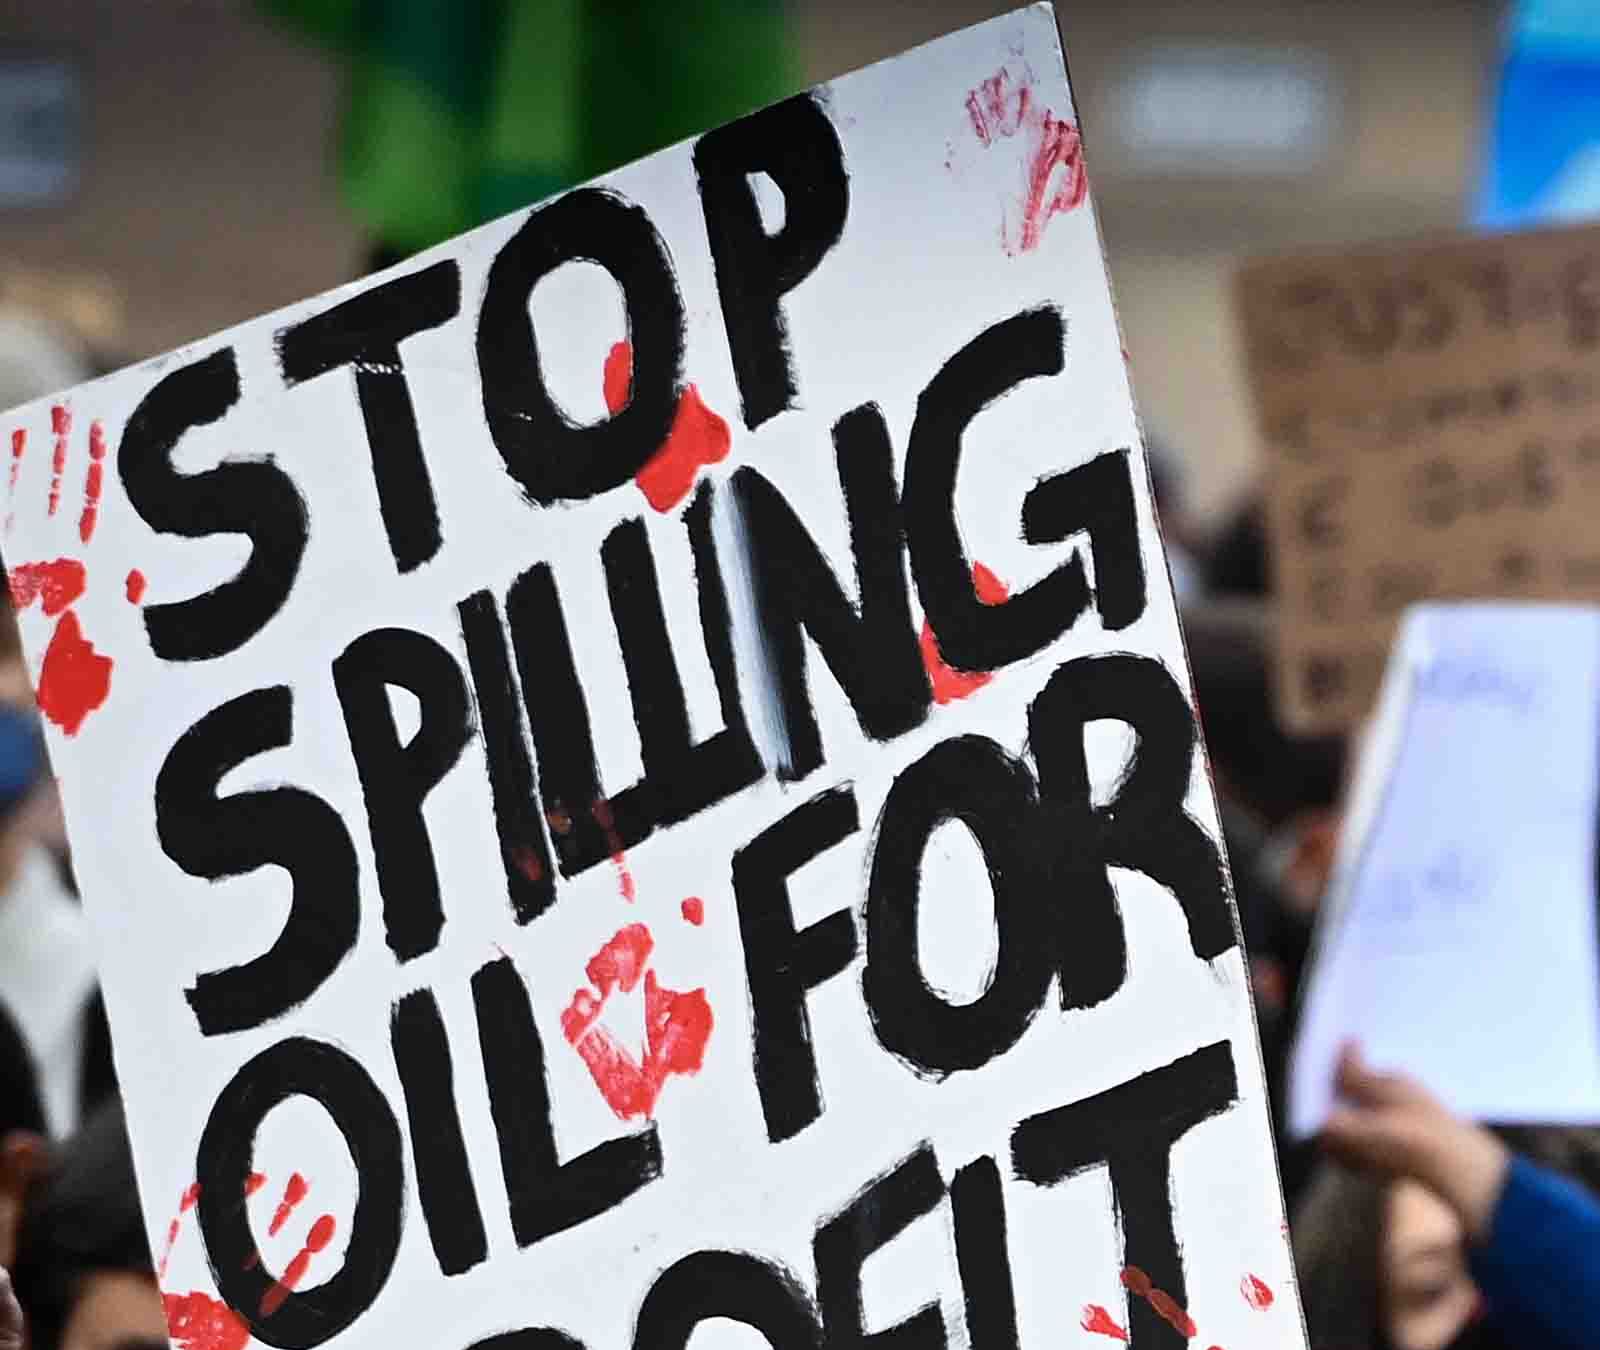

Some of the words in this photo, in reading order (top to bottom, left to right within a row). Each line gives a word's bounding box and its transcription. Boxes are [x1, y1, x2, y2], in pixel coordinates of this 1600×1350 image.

[117, 90, 850, 662] STOP
[155, 303, 1146, 1036] SPILLING
[732, 653, 1238, 1144] FOR
